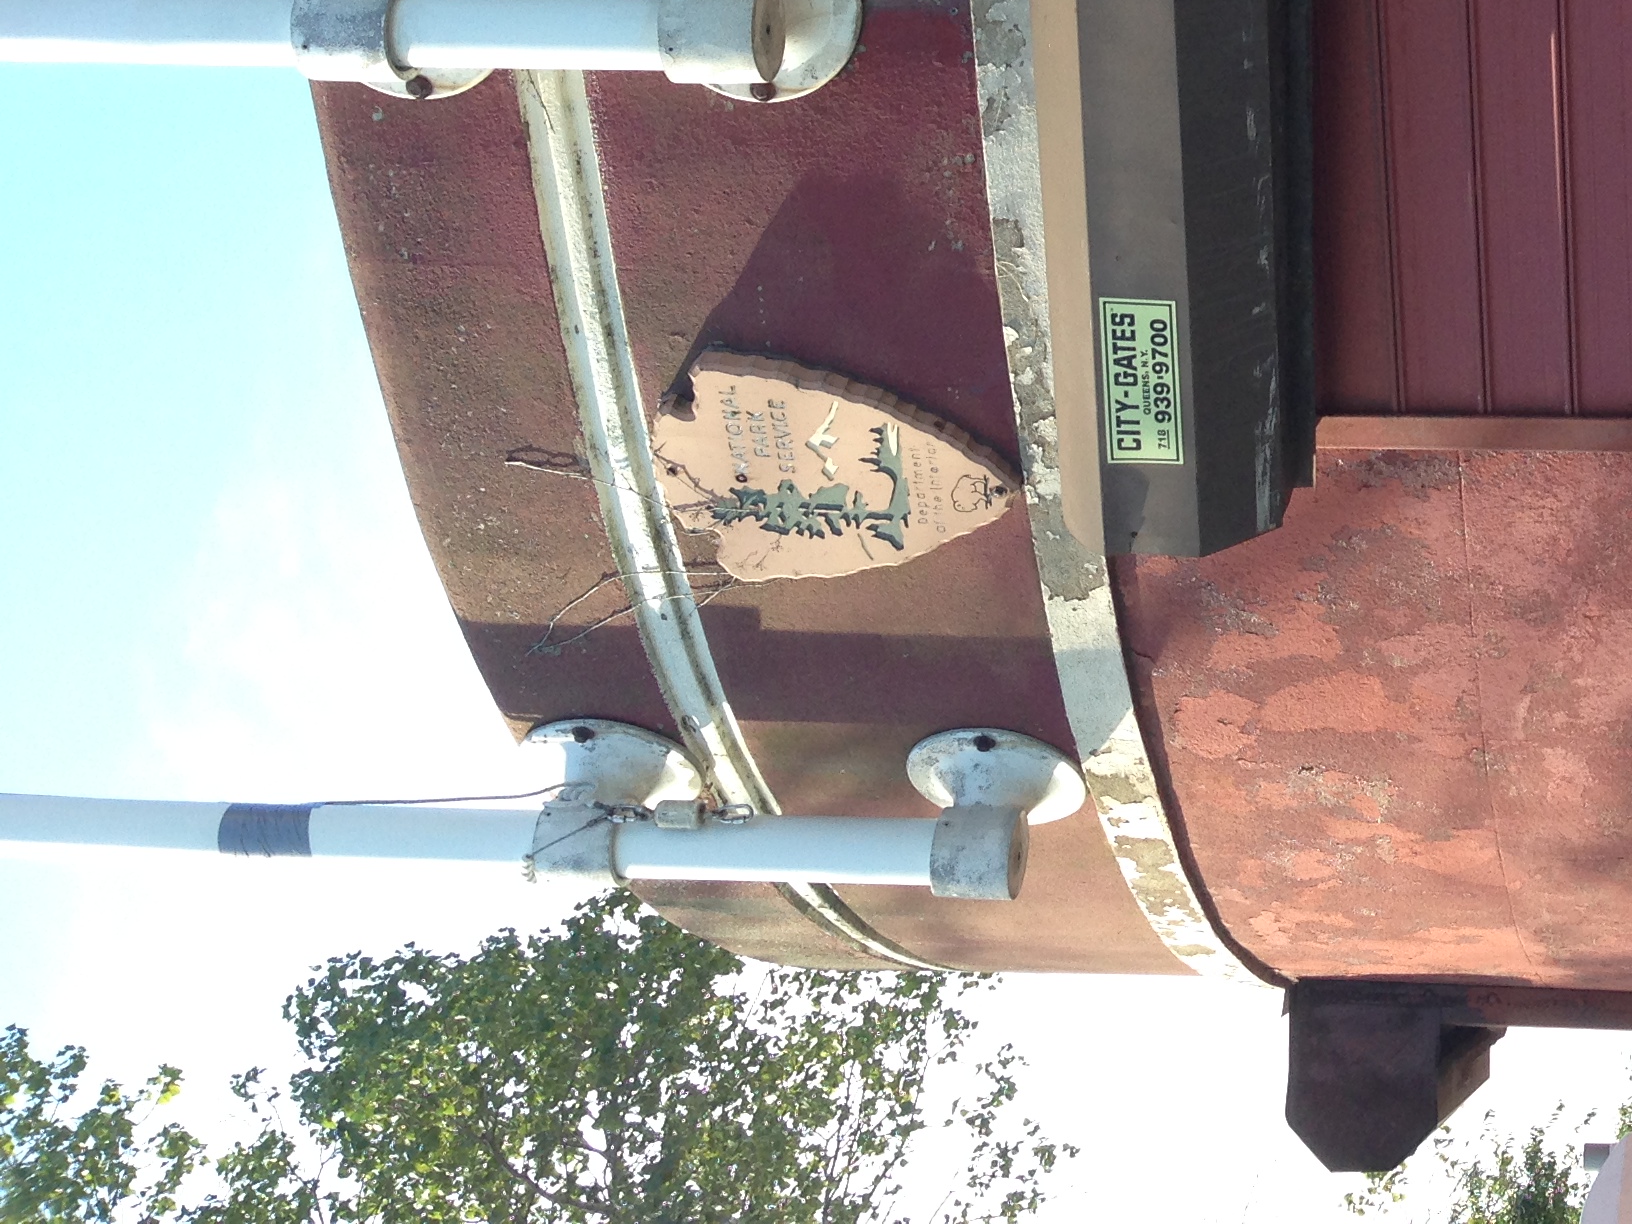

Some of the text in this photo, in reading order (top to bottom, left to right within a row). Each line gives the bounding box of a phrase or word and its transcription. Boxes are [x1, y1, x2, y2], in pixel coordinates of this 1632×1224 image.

[1110, 312, 1142, 452] CITY-GATES
[718, 385, 749, 474] NATIONAL
[746, 410, 770, 458] PARK
[767, 398, 796, 473] SERVICE
[1157, 429, 1170, 450] 718
[908, 444, 929, 524] Department
[926, 441, 942, 490] Interior
[934, 519, 947, 533] of
